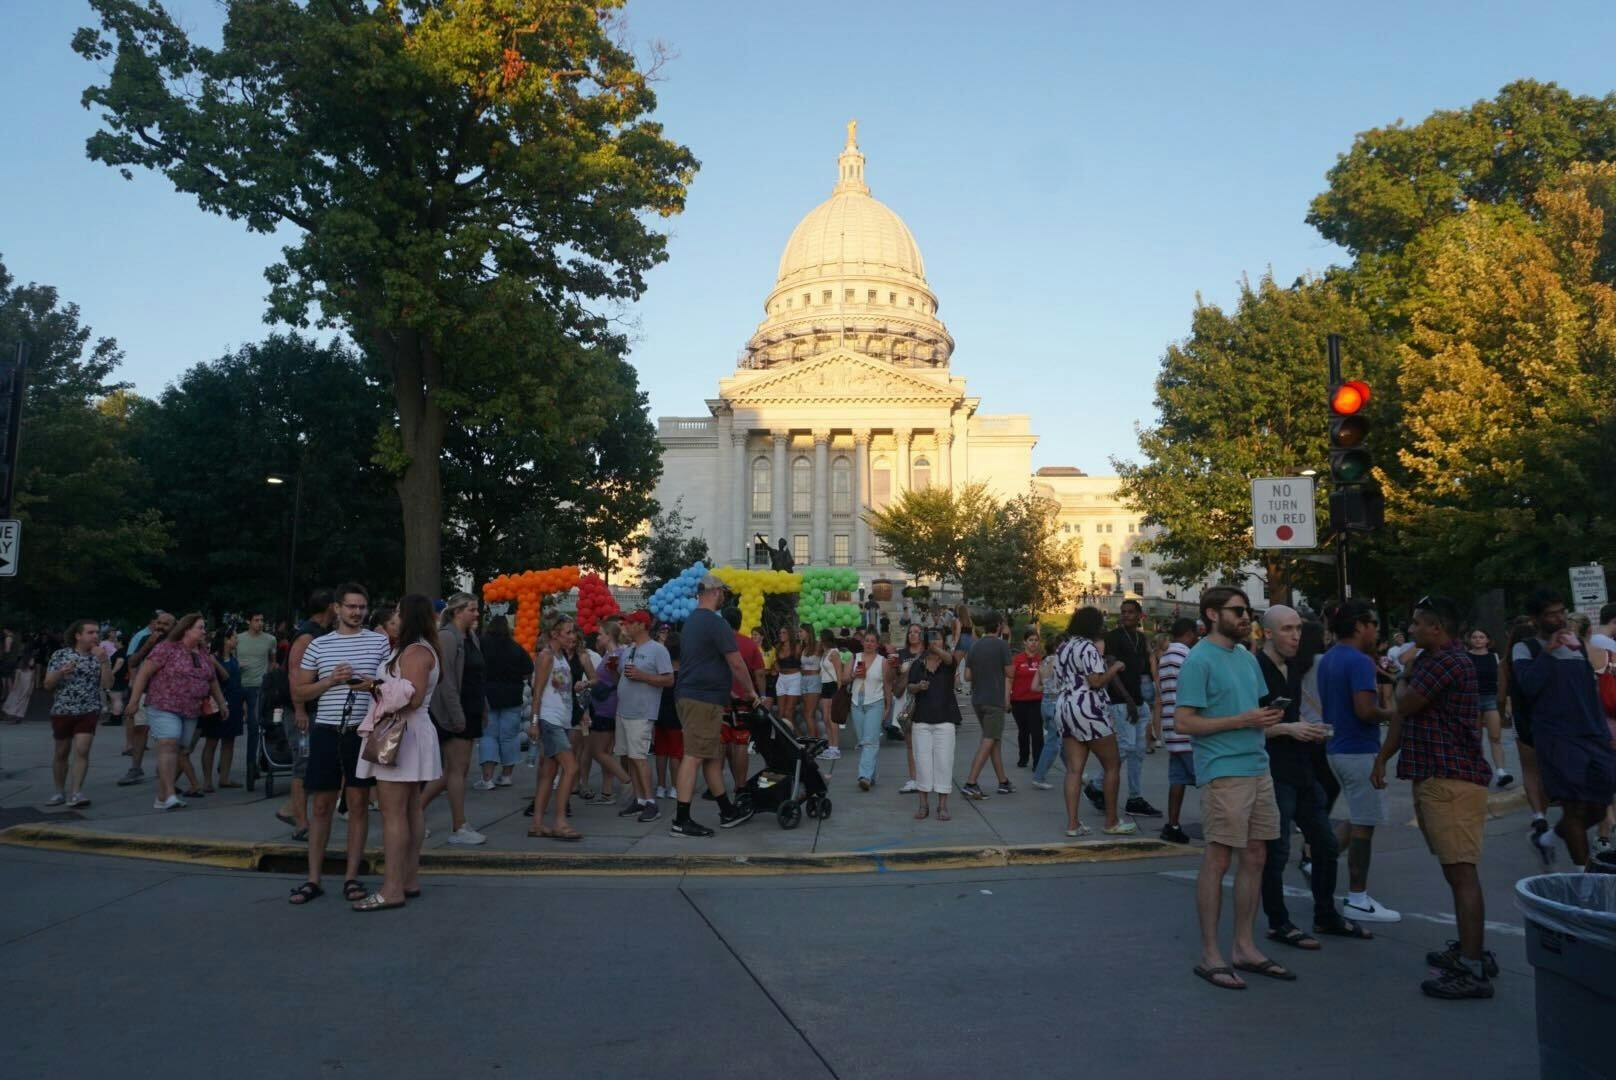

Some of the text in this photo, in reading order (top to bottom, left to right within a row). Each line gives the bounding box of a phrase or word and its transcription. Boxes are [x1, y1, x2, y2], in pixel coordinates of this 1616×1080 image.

[1272, 484, 1291, 497] NO
[1268, 500, 1298, 511] TURN
[1262, 513, 1306, 525] ON RED
